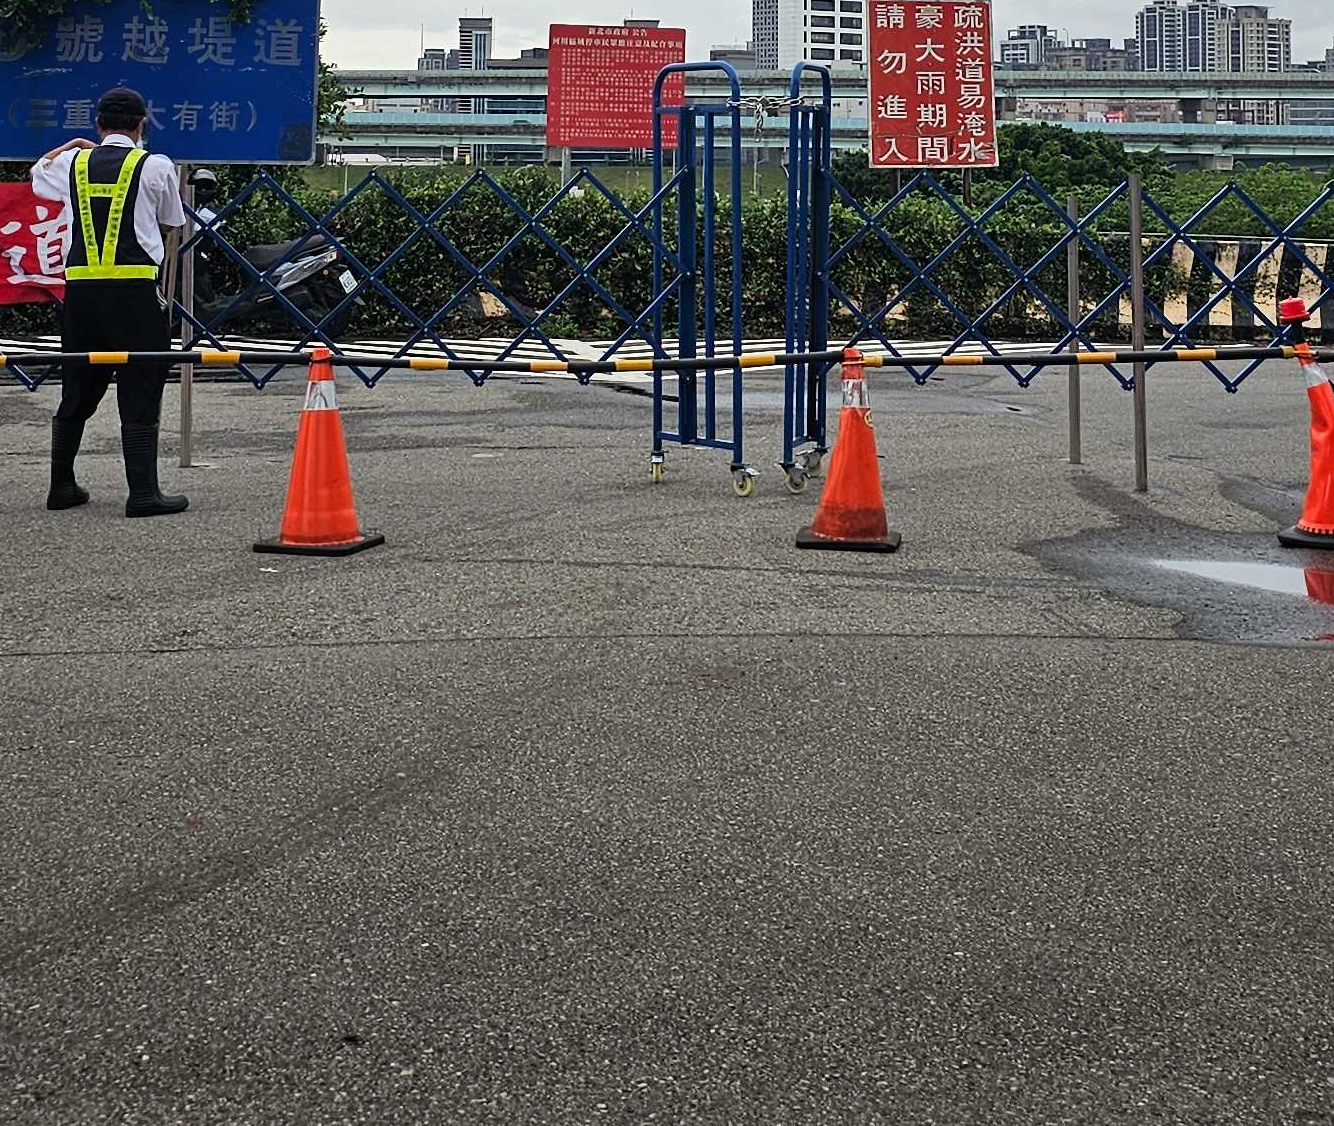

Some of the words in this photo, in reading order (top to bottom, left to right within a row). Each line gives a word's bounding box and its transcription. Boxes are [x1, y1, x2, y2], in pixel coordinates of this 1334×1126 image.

[7, 97, 258, 133] （三重大有街）
[874, 3, 909, 163] 請勿進入
[914, 4, 949, 163] 豪大雨期間
[953, 4, 987, 163] 疏洪道易淹水
